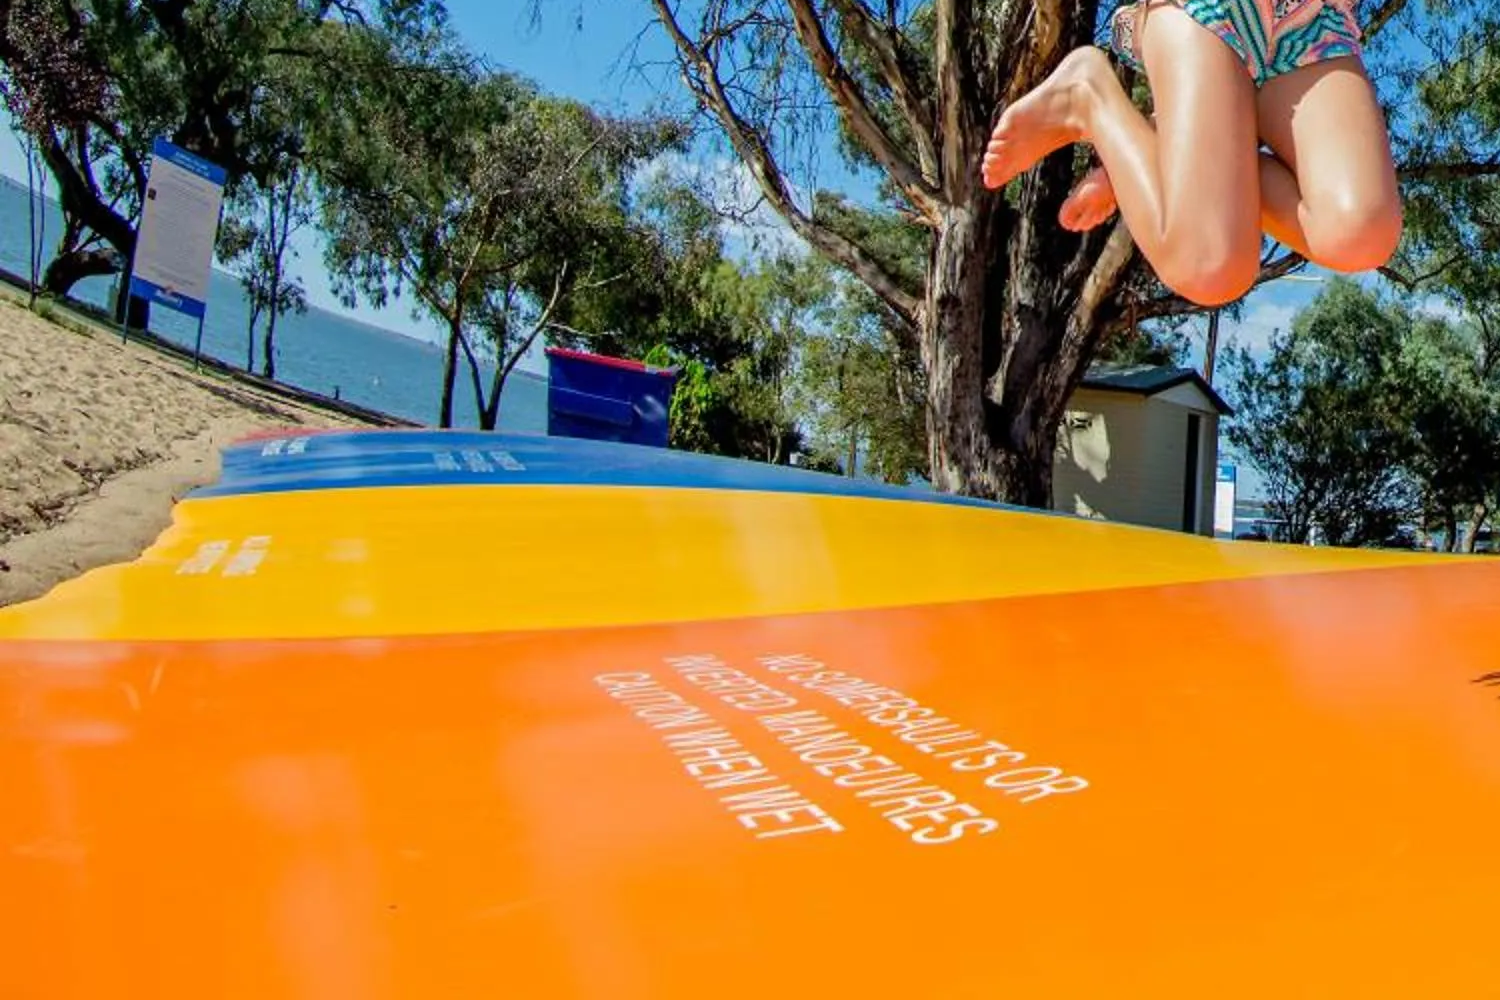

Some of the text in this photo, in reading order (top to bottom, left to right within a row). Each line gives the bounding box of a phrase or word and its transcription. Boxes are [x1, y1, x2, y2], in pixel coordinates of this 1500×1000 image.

[593, 671, 846, 839] CAUTION WHEN WET
[661, 653, 999, 844] INVERTED MANOEUVRES
[984, 765, 1089, 804] OR
